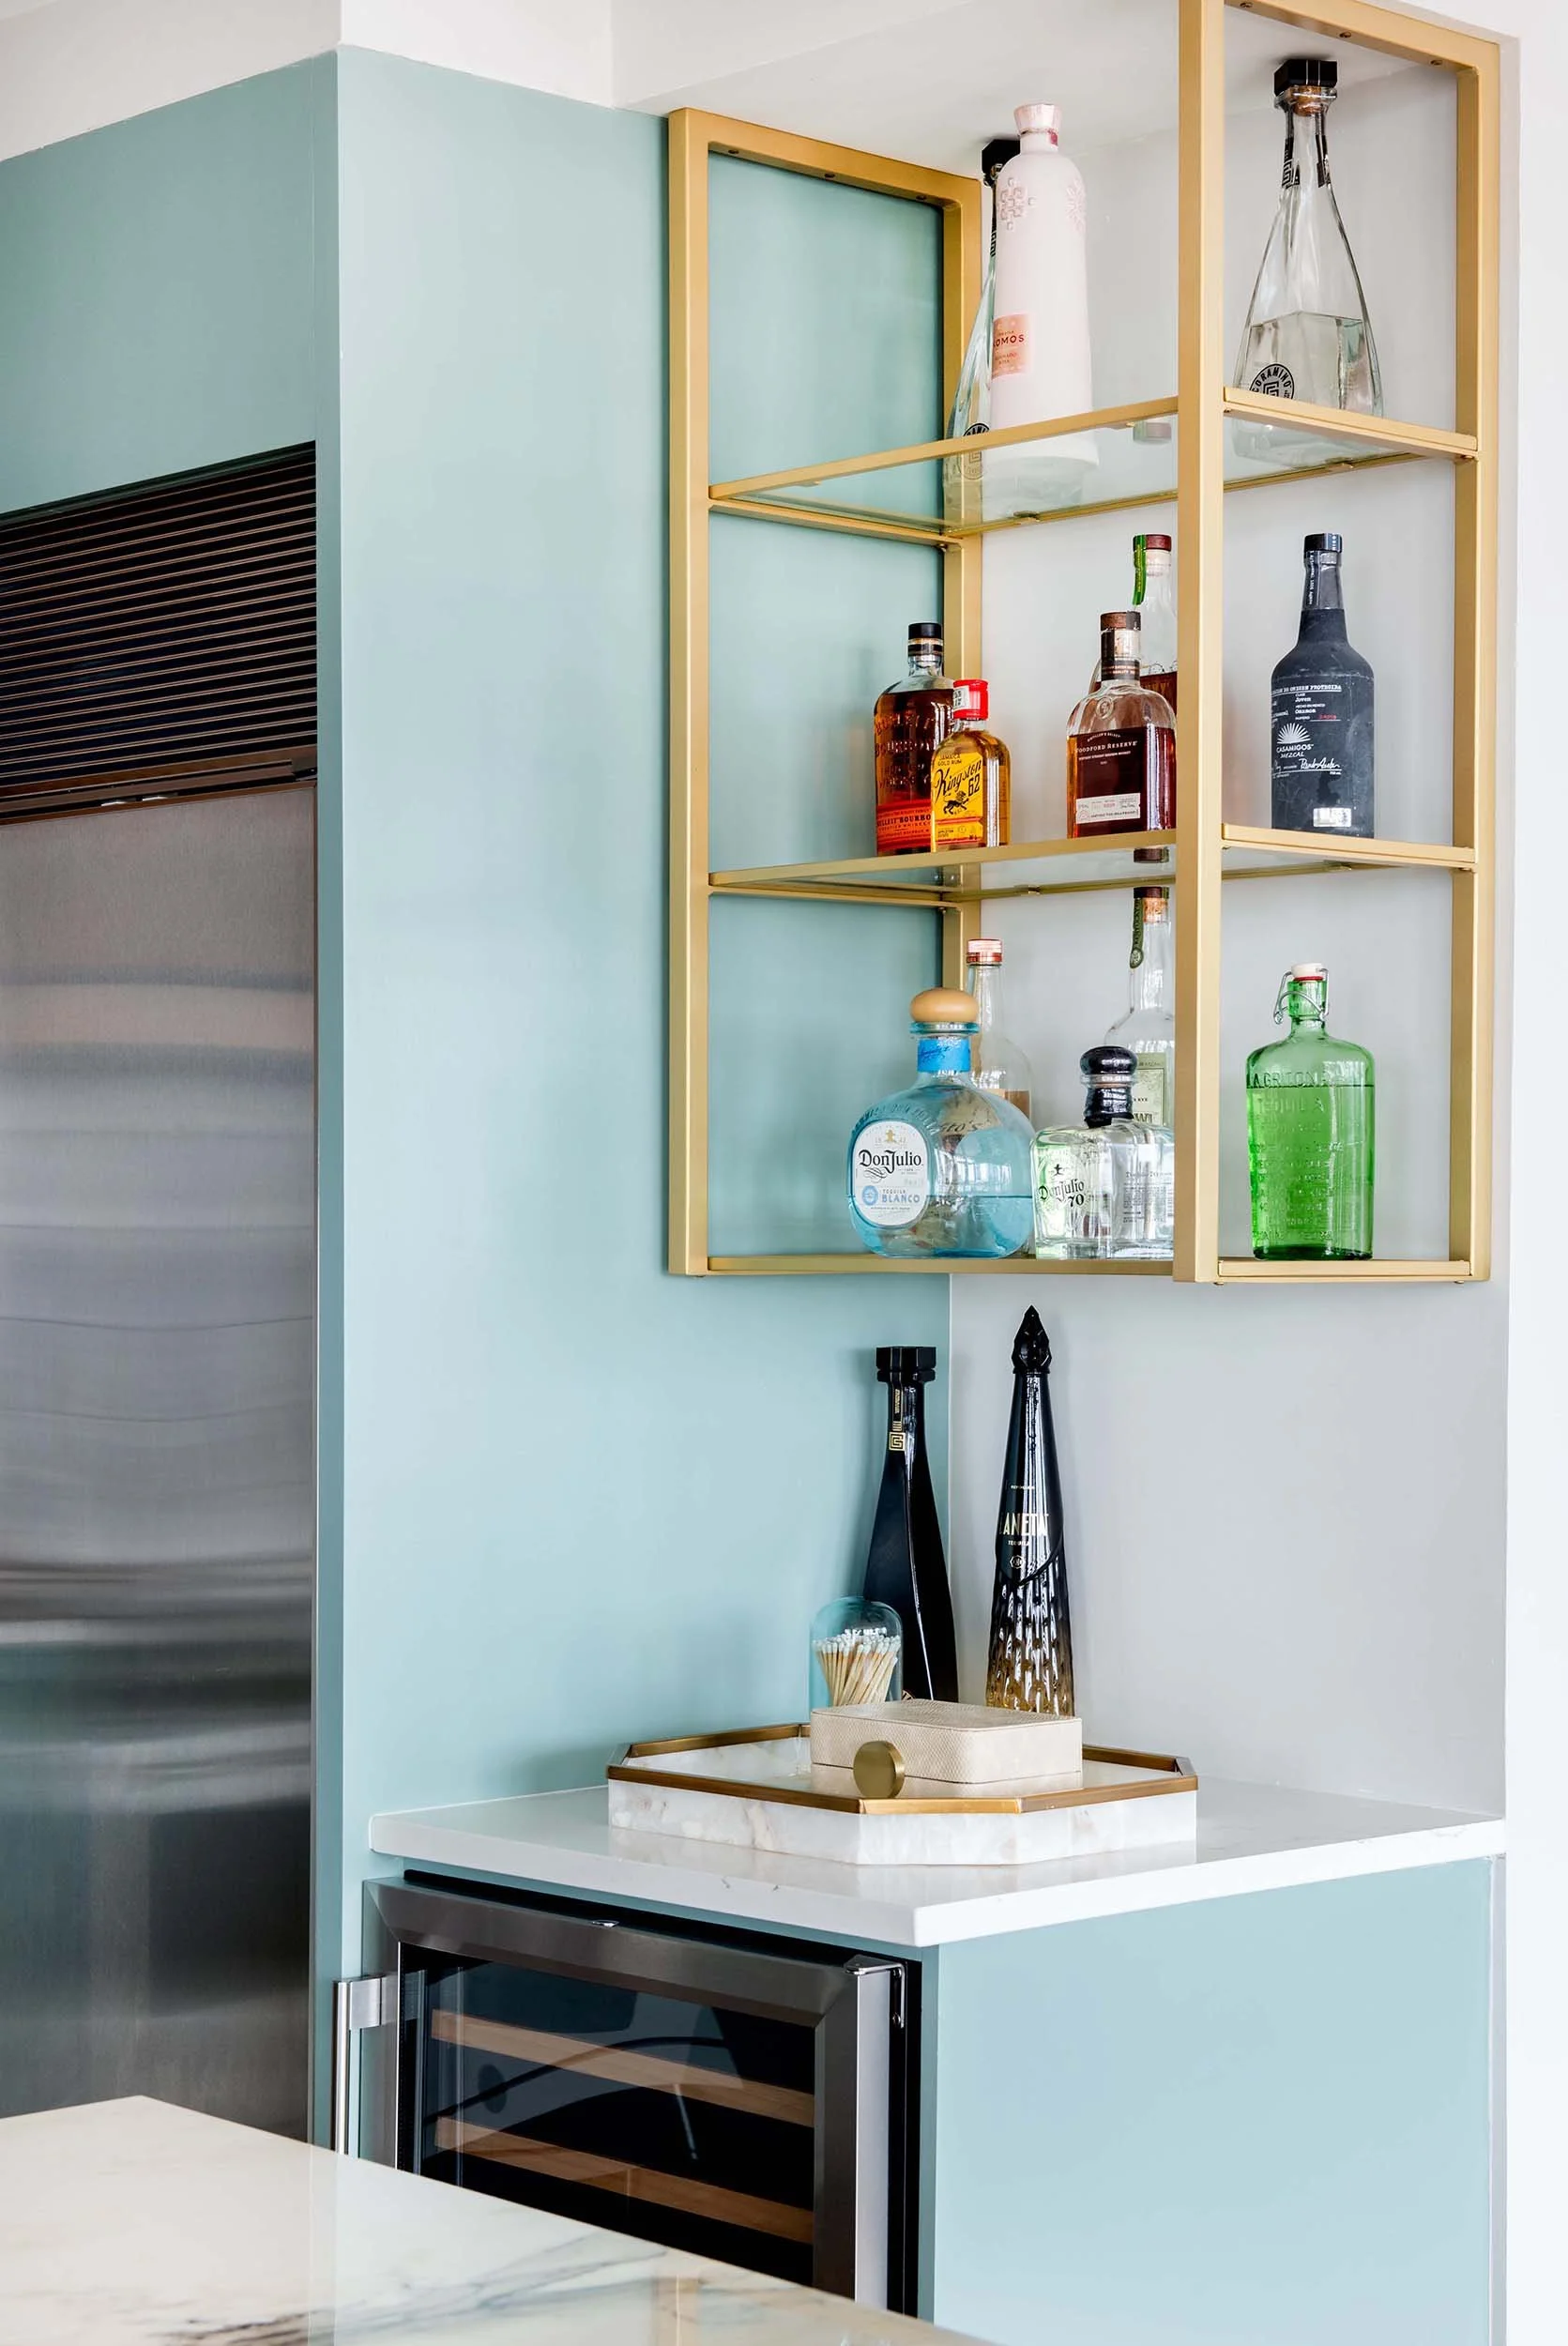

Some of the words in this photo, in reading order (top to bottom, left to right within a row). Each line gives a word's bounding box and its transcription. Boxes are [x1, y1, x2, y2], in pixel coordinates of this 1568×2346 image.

[1252, 367, 1292, 393] CORAMINO
[1276, 744, 1313, 753] CASAMIGOS
[934, 760, 982, 804] Kingston
[968, 773, 981, 797] 62
[900, 814, 932, 824] BOURBO
[881, 1194, 921, 1204] BLANCO
[1068, 1194, 1085, 1208] 70
